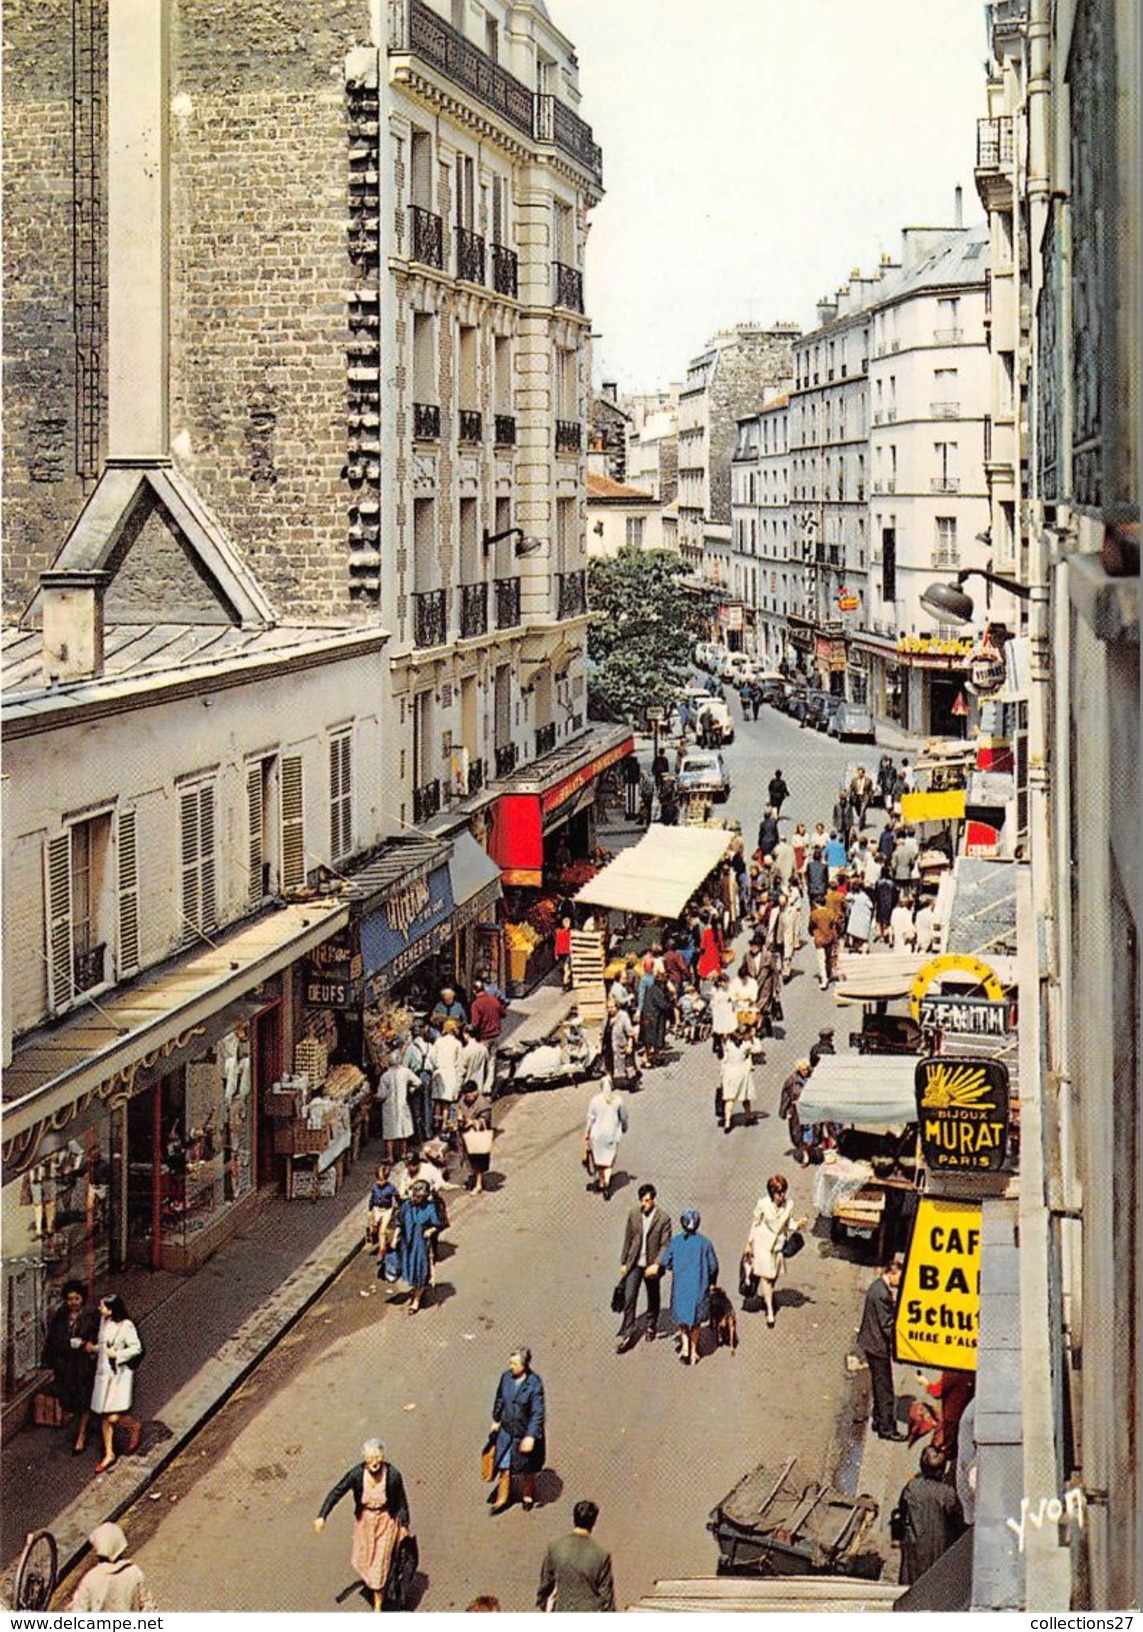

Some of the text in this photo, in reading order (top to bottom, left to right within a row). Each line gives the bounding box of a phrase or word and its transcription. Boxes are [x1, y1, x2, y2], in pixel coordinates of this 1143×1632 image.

[920, 1003, 1005, 1034] ZENITH
[938, 1110, 988, 1120] BIJOUX
[925, 1120, 1004, 1154] MURAT
[938, 1155, 990, 1167] PARIS
[918, 1264, 980, 1295] BA
